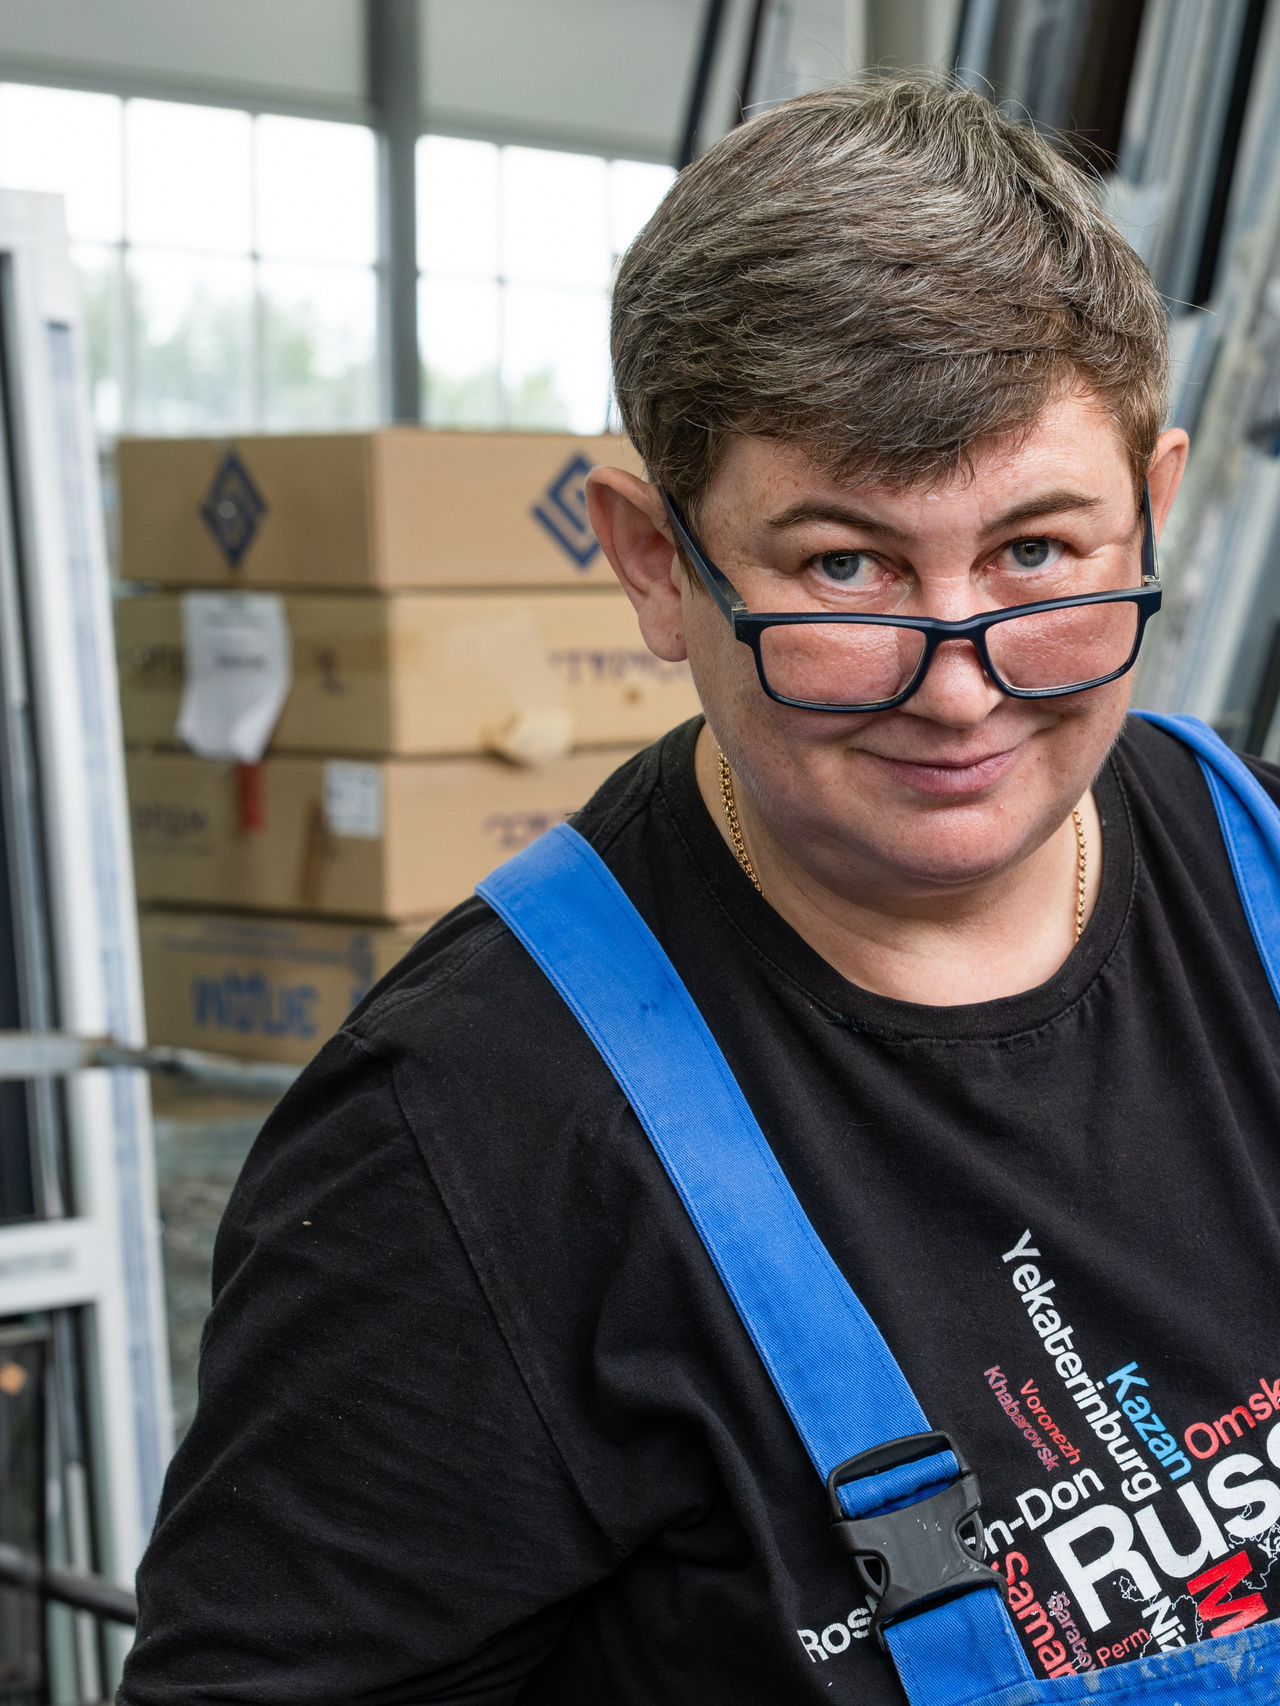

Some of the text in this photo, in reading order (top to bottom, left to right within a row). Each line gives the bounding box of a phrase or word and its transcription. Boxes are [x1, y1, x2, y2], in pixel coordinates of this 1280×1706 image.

[1001, 1228, 1162, 1502] Yekaterinburg
[983, 1365, 1060, 1472] Khabarovsk
[1020, 1378, 1080, 1465] Voronezh
[1106, 1361, 1192, 1480] Kazan
[1048, 1593, 1097, 1671] Sarato
[1096, 1628, 1150, 1667] Perm
